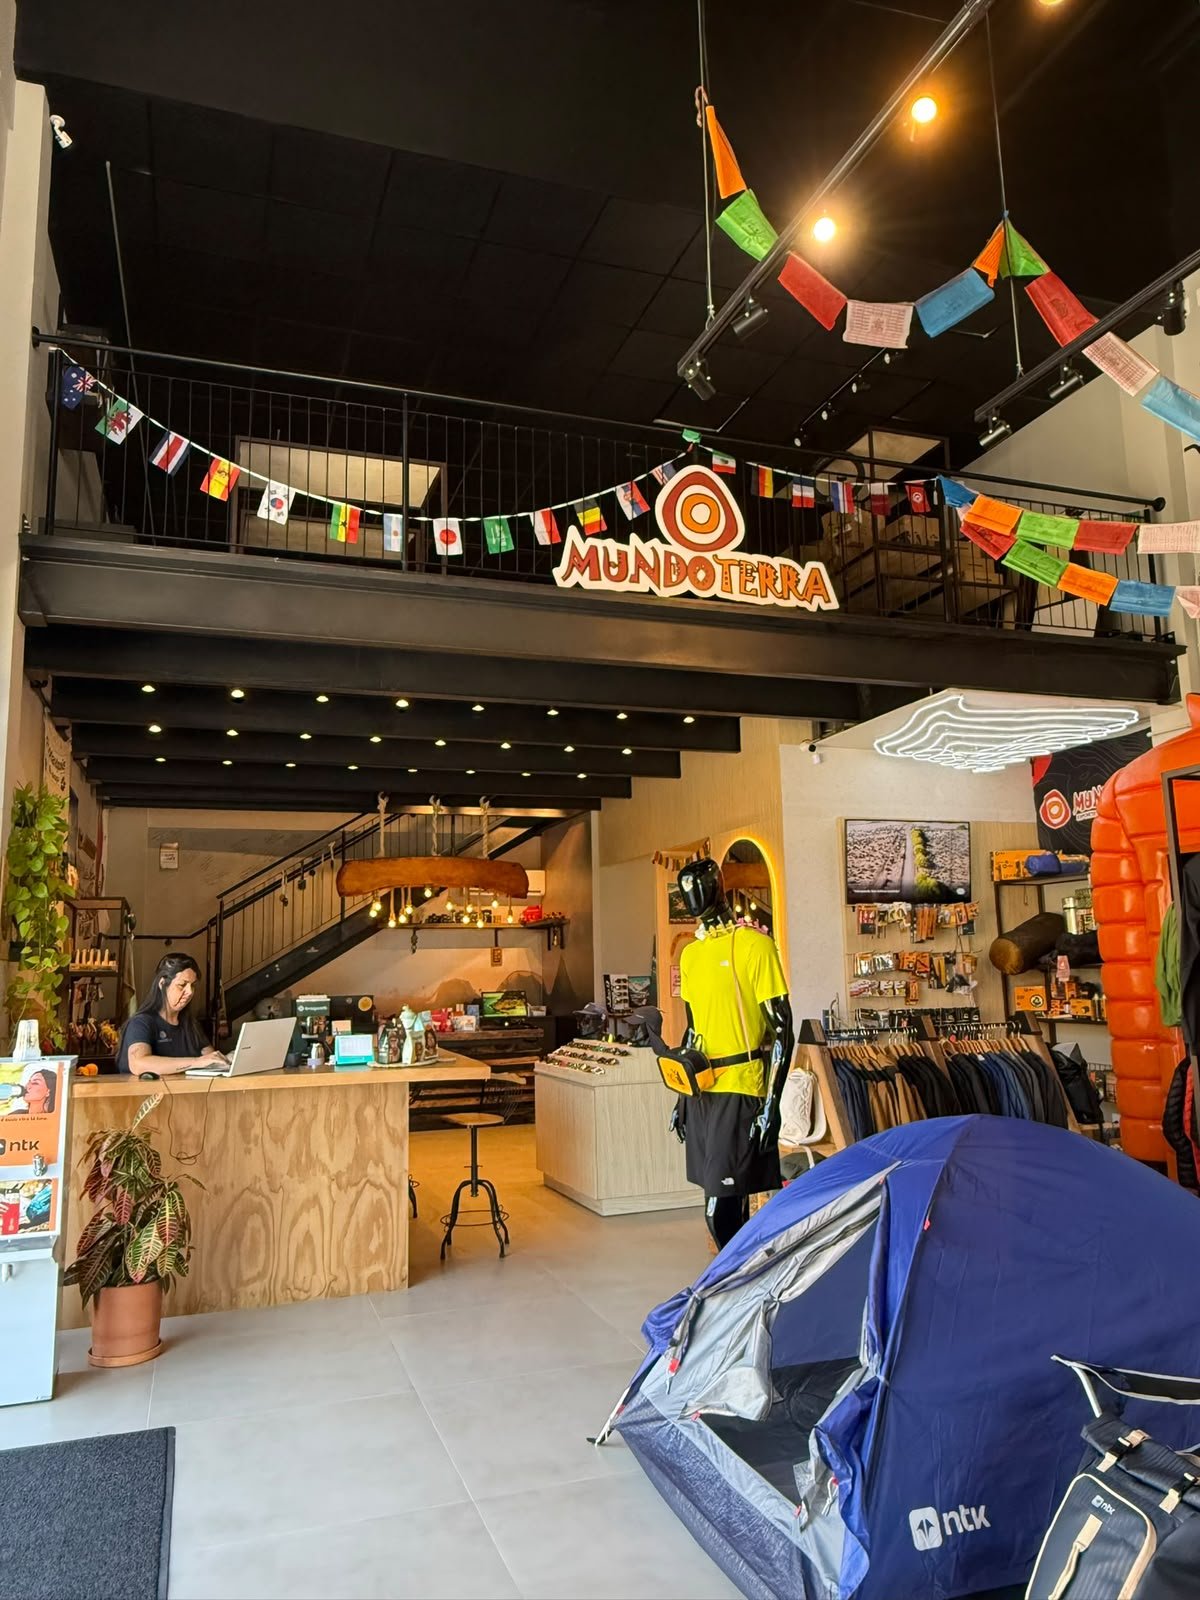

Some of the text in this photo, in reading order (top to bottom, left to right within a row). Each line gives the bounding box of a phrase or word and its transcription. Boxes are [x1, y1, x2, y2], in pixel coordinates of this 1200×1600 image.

[559, 540, 833, 605] MUNDOTERRA
[9, 1139, 40, 1152] ntk
[942, 1504, 992, 1536] ntk
